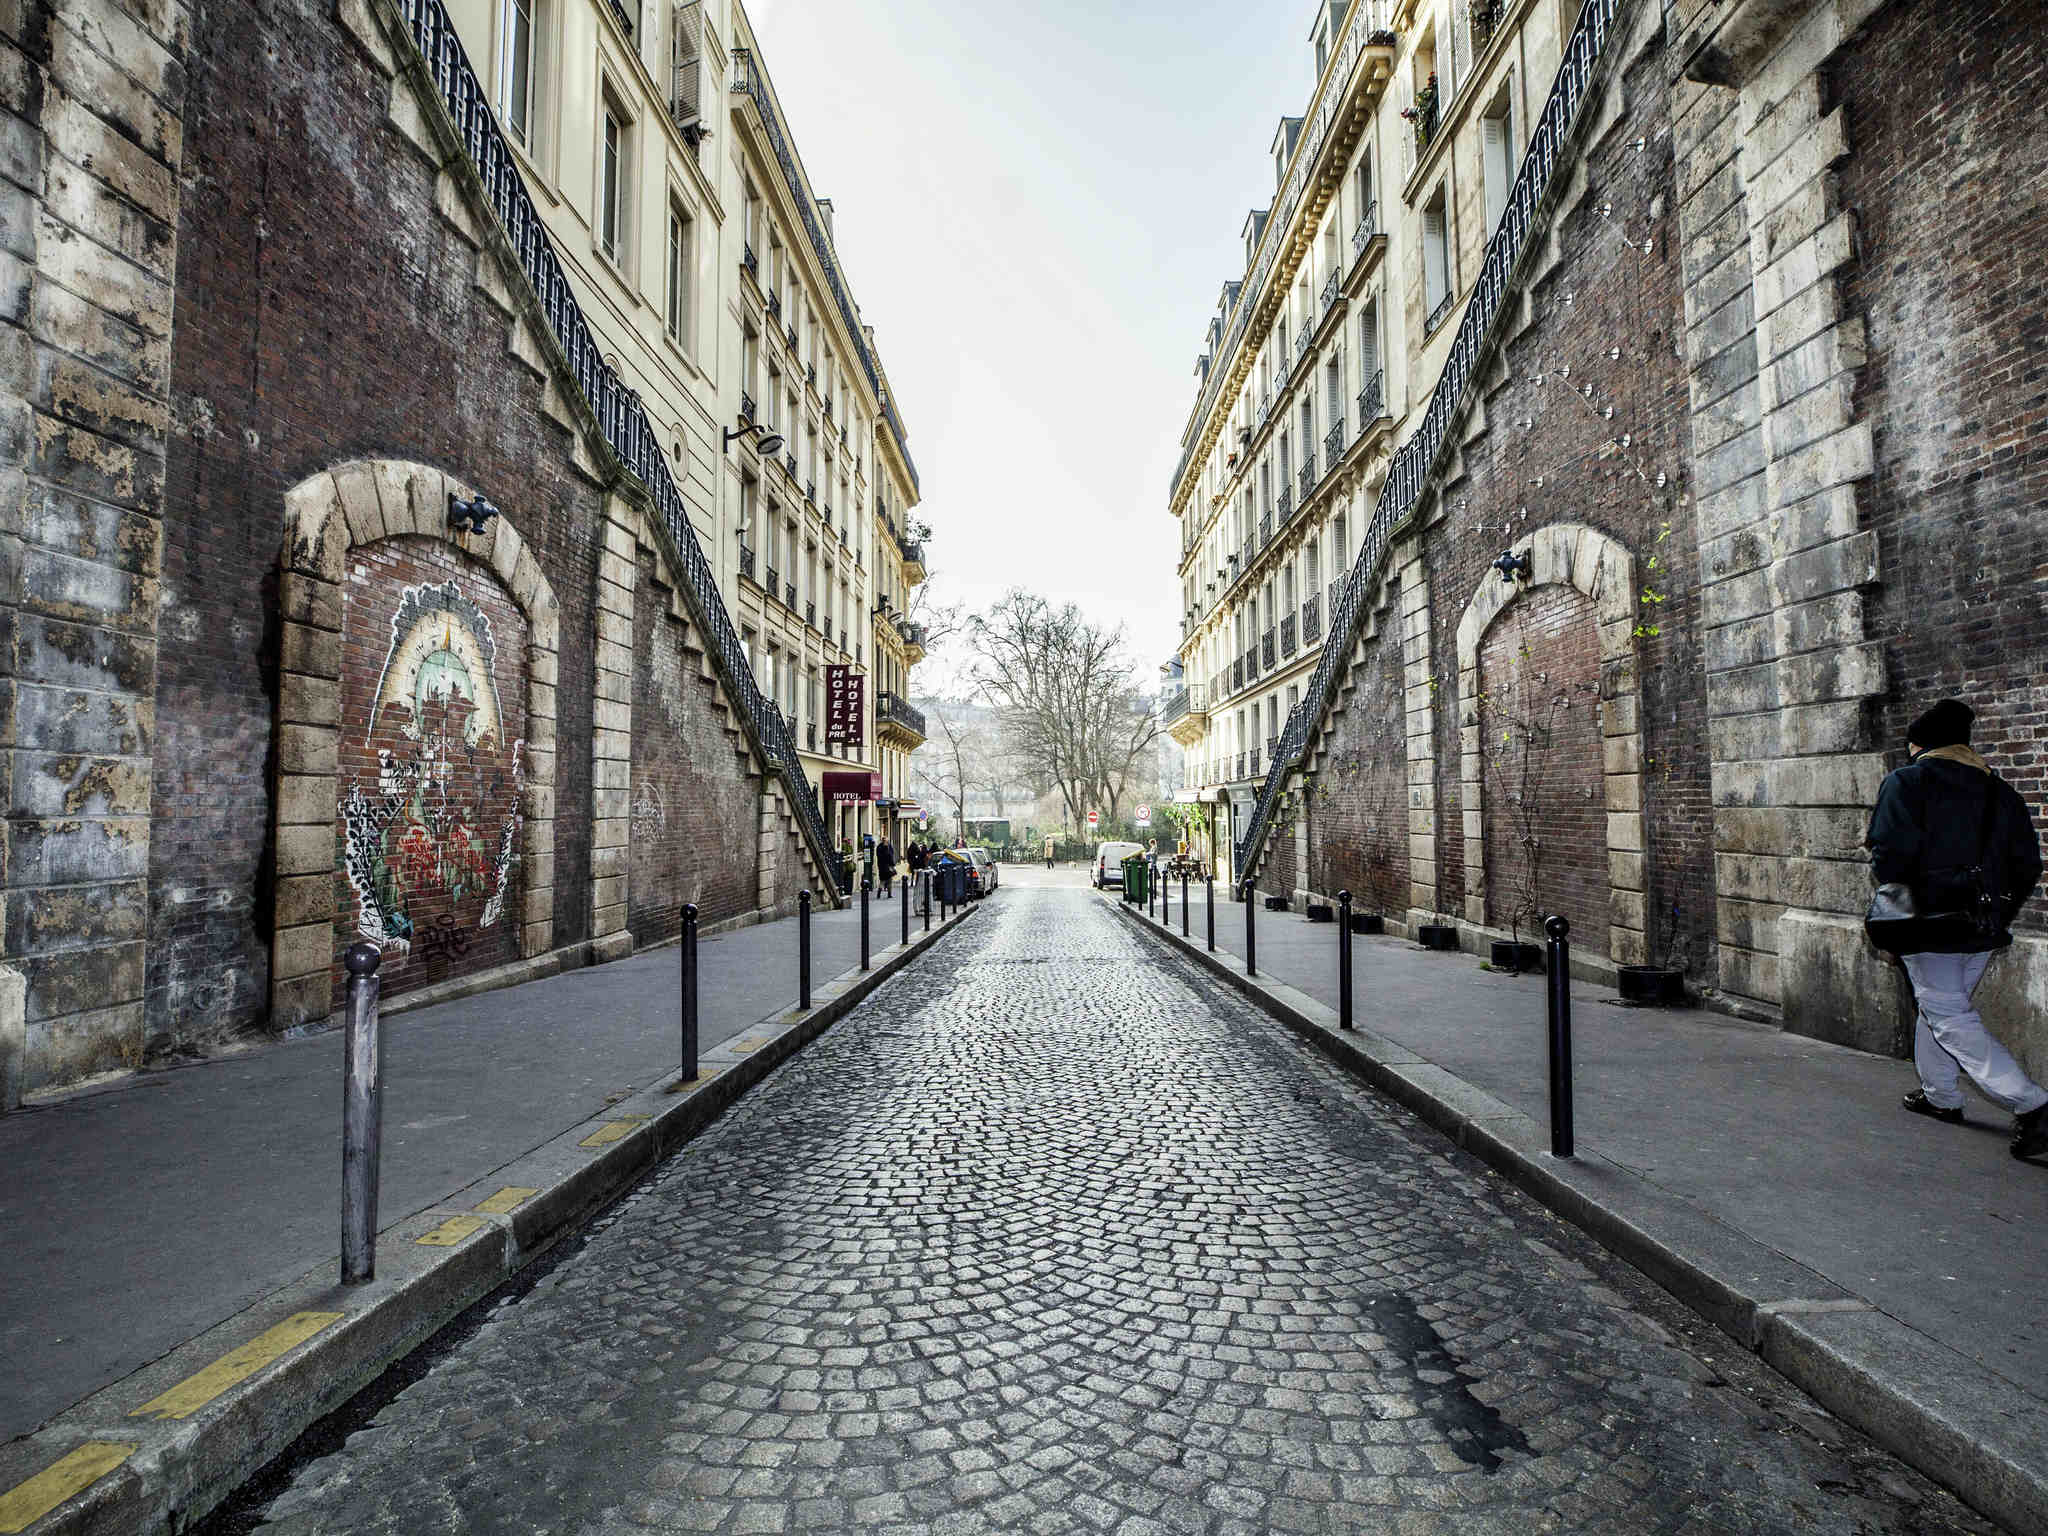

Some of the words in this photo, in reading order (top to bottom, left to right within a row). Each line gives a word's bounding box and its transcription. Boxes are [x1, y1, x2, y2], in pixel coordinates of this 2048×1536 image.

[832, 670, 843, 718] HOTEL
[848, 680, 858, 733] HOTEL
[833, 792, 861, 800] HOTEL
